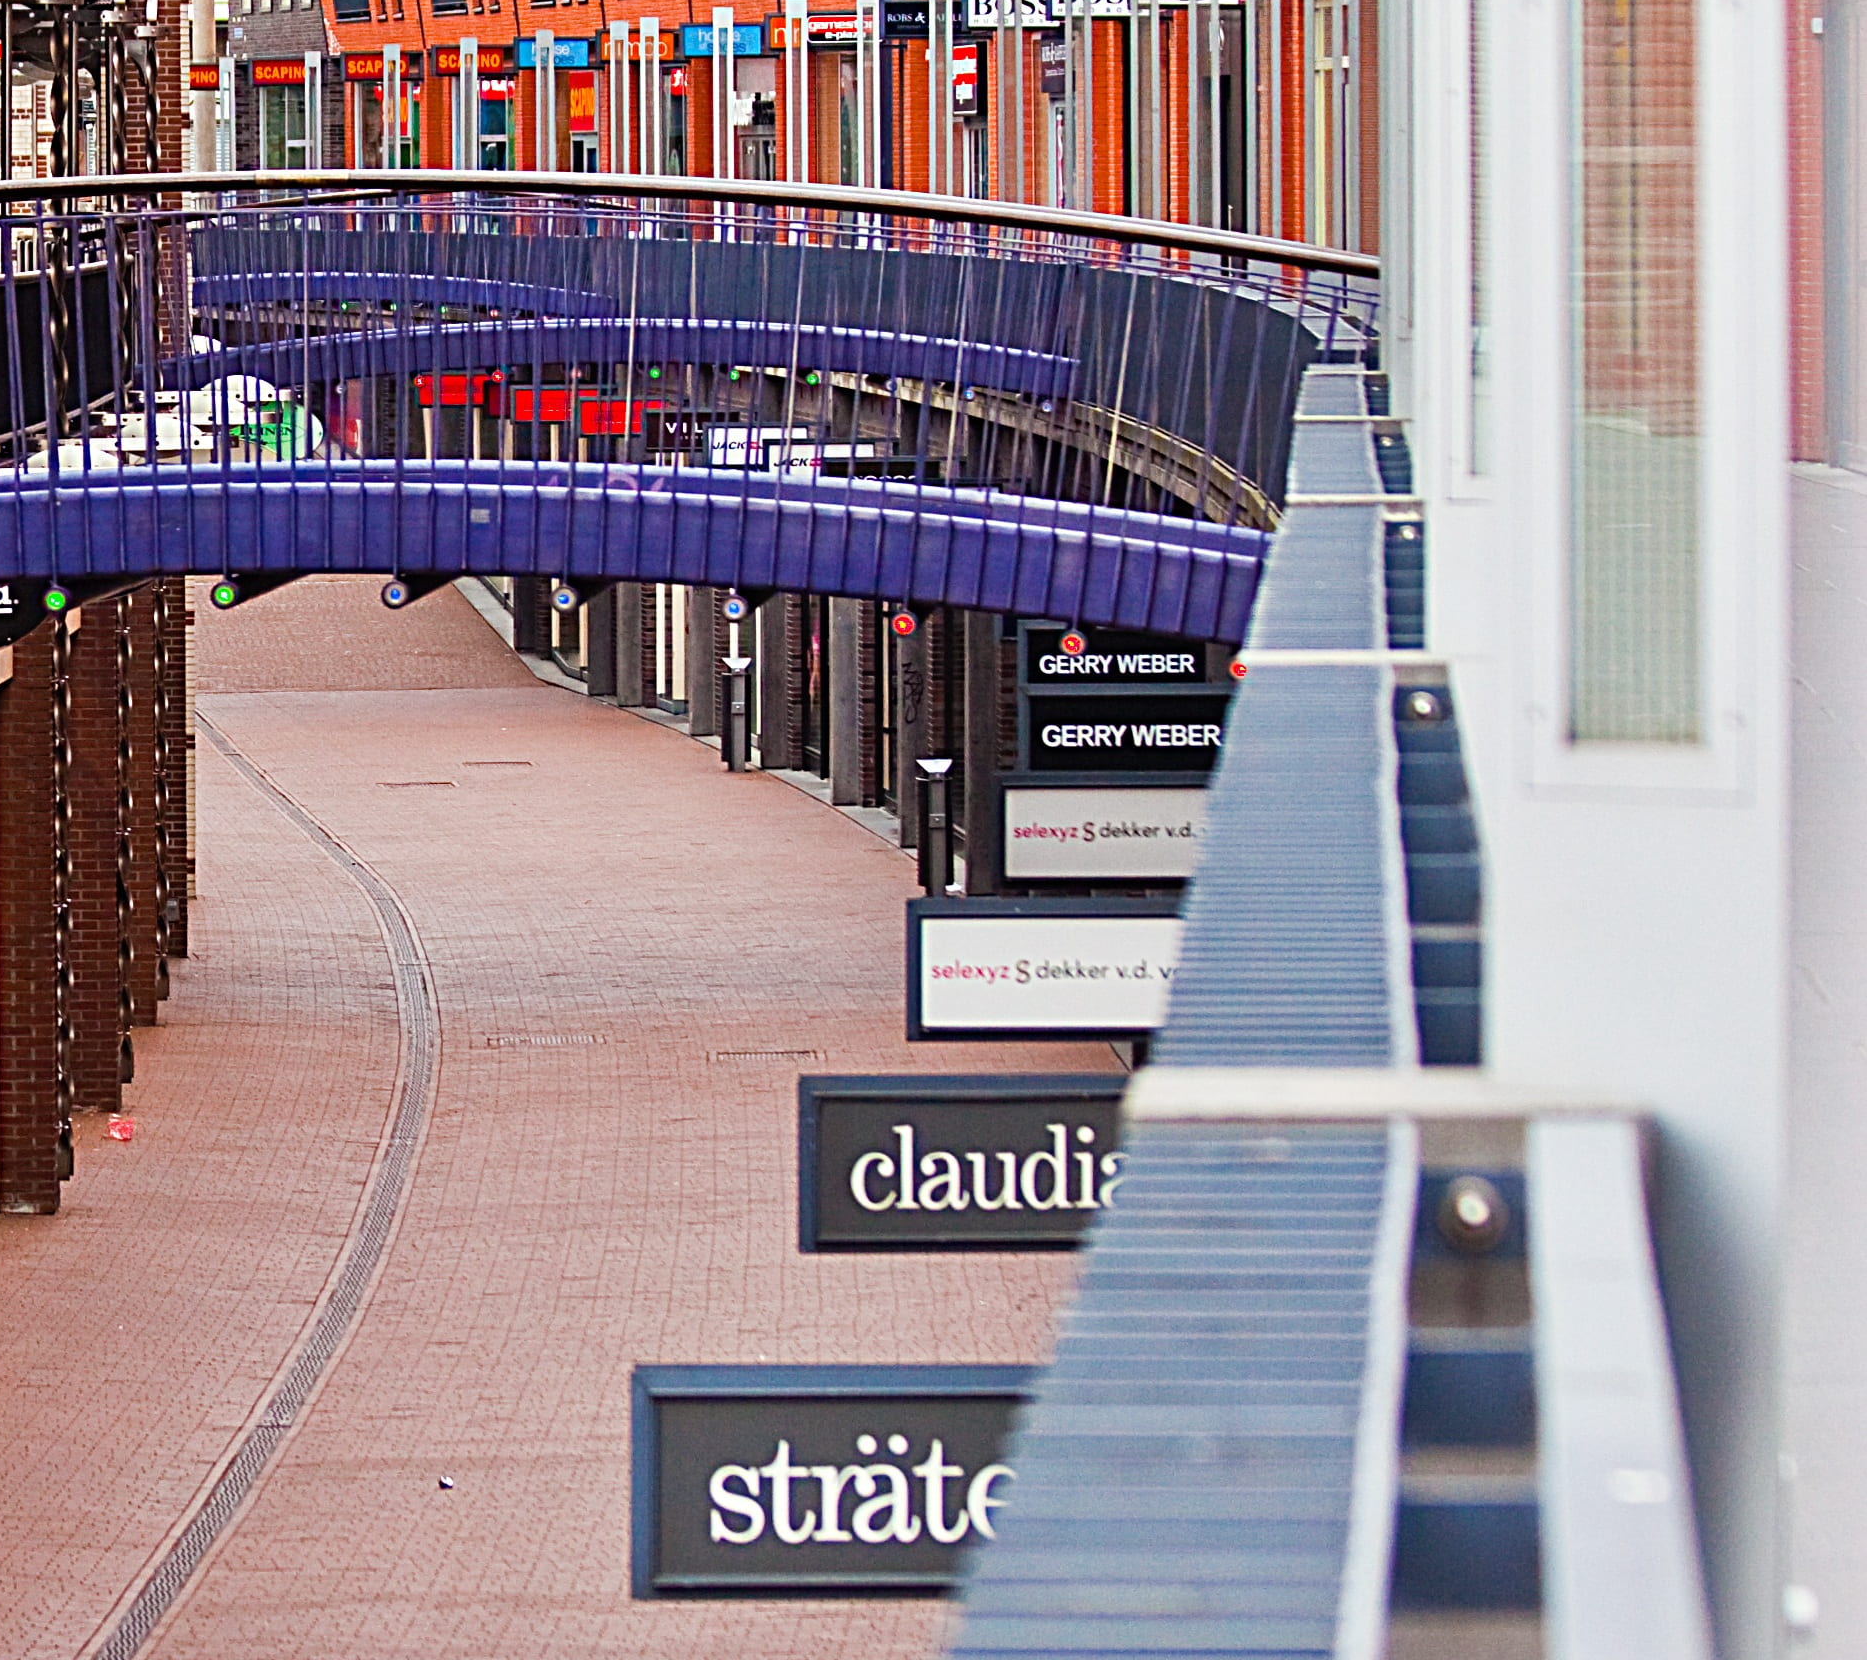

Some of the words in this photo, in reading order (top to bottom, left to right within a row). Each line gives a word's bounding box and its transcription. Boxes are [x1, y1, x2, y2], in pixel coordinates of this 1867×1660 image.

[189, 71, 218, 84] PINO
[1039, 654, 1113, 674] GERRY
[1116, 653, 1195, 674] WEBER
[1041, 724, 1127, 747] GERRY
[1130, 723, 1222, 747] WEBER
[1013, 822, 1078, 843] selexyz
[1098, 821, 1160, 839] dekker
[931, 959, 1011, 985] selexyz
[1035, 959, 1109, 980] dekker
